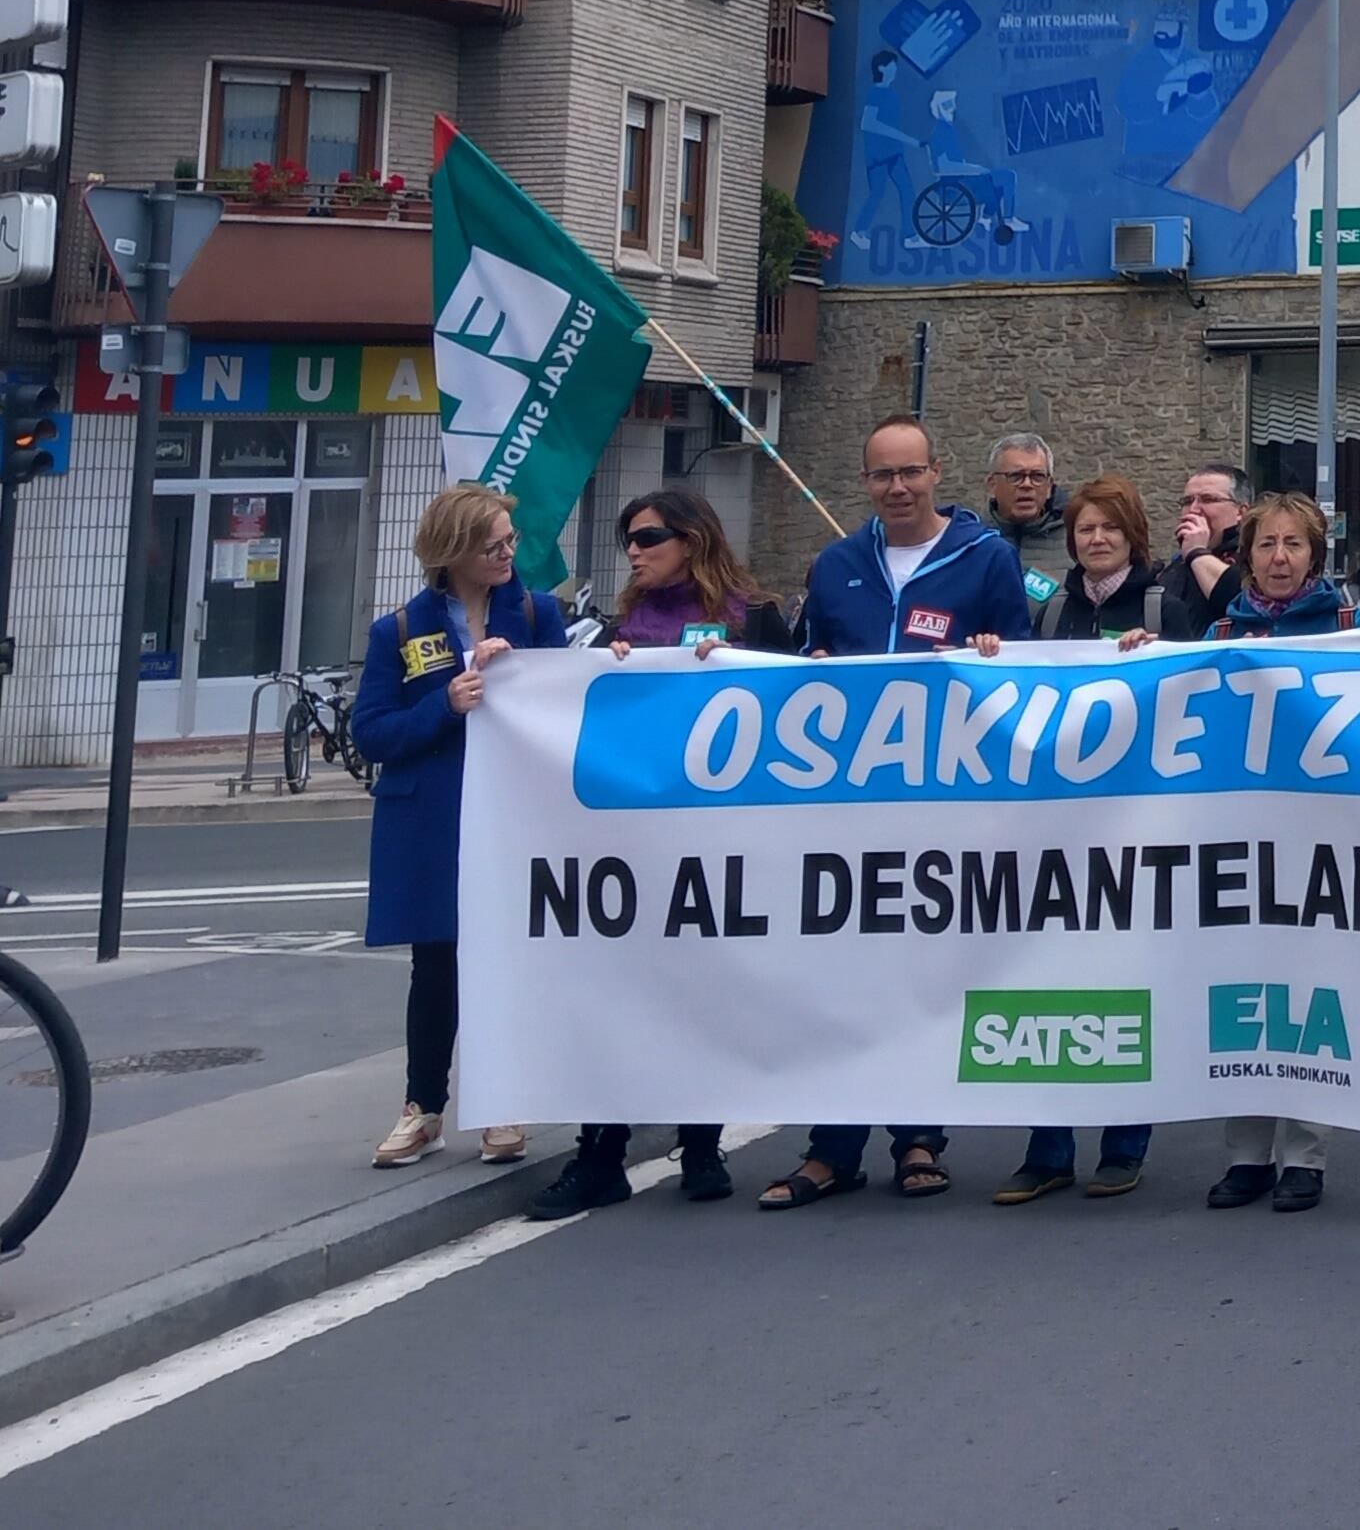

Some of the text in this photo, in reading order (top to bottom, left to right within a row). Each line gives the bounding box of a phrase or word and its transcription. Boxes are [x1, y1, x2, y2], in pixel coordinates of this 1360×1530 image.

[1026, 13, 1120, 27] INTERNACIONAL
[912, 614, 946, 632] LAB
[529, 855, 638, 938] NO
[664, 855, 769, 938] AL
[970, 1012, 1144, 1067] SATSE
[1208, 982, 1352, 1062] ELA
[1209, 1062, 1352, 1088] EUSKAL SINDIKATUA
